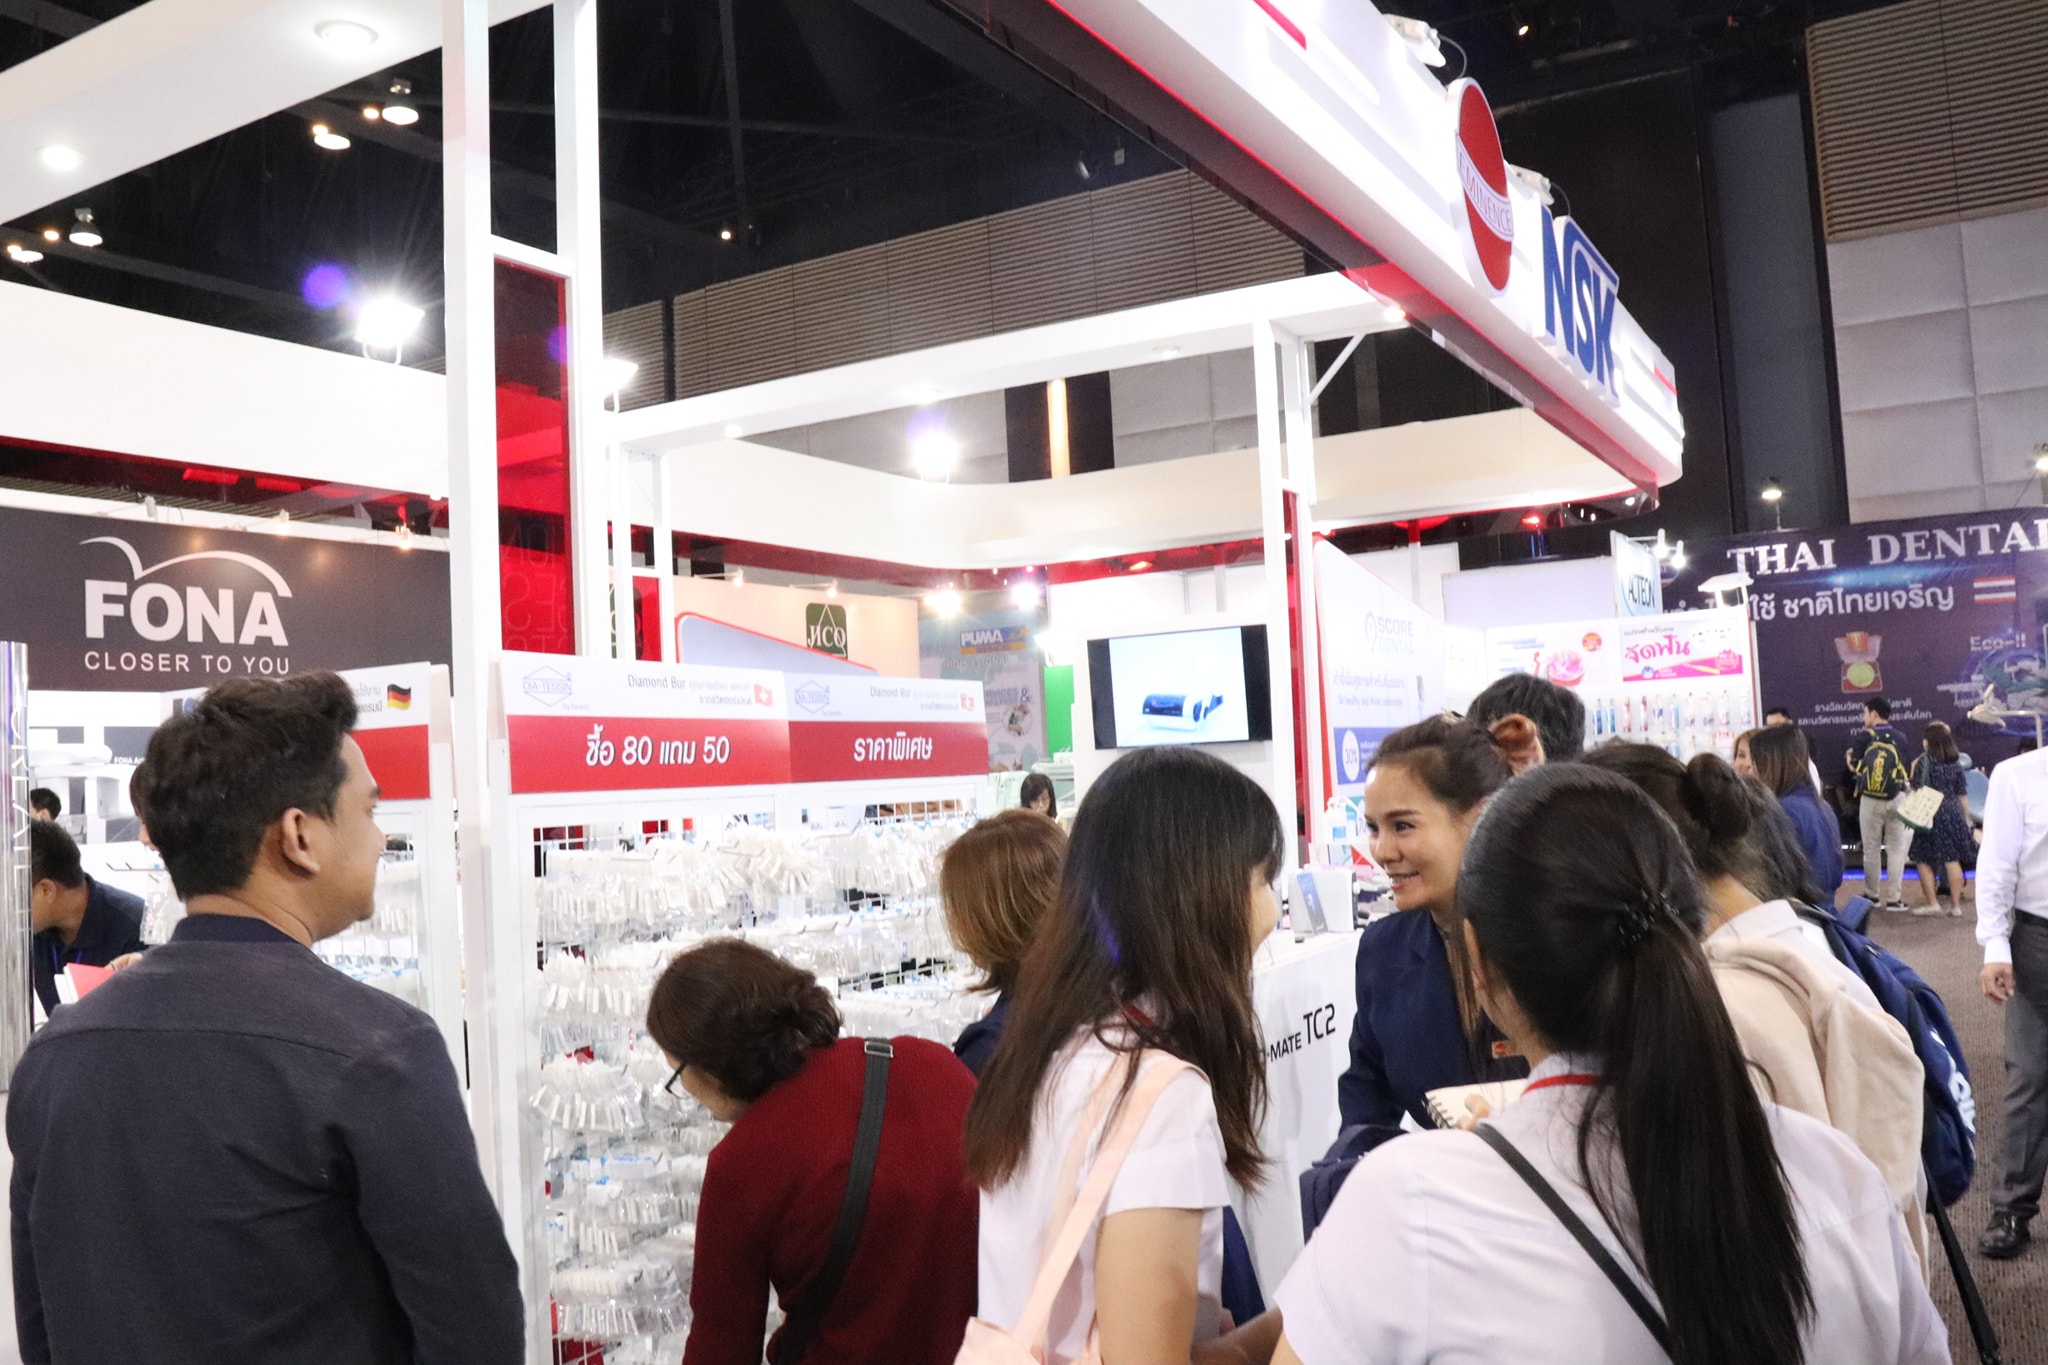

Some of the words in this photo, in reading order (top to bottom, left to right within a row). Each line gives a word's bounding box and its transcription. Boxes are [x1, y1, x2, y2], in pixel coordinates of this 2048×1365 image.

[1458, 152, 1512, 233] EMINENCE
[1541, 204, 1618, 400] NSK
[1726, 539, 1837, 575] THAI
[84, 579, 289, 646] FONA
[1783, 583, 1954, 619] ชาติไทยเจริญ
[961, 629, 1004, 646] PUMA
[1377, 616, 1413, 637] SCORE
[84, 651, 190, 672] CLOSER
[201, 654, 232, 673] TO
[243, 656, 290, 675] YOU
[628, 674, 668, 689] Diamond
[670, 676, 686, 690] Bur
[622, 735, 653, 766] 80
[659, 739, 696, 766] แถม
[702, 735, 731, 765] 50
[853, 730, 933, 762] ราคาพิเศษ
[1303, 1003, 1336, 1045] TC2
